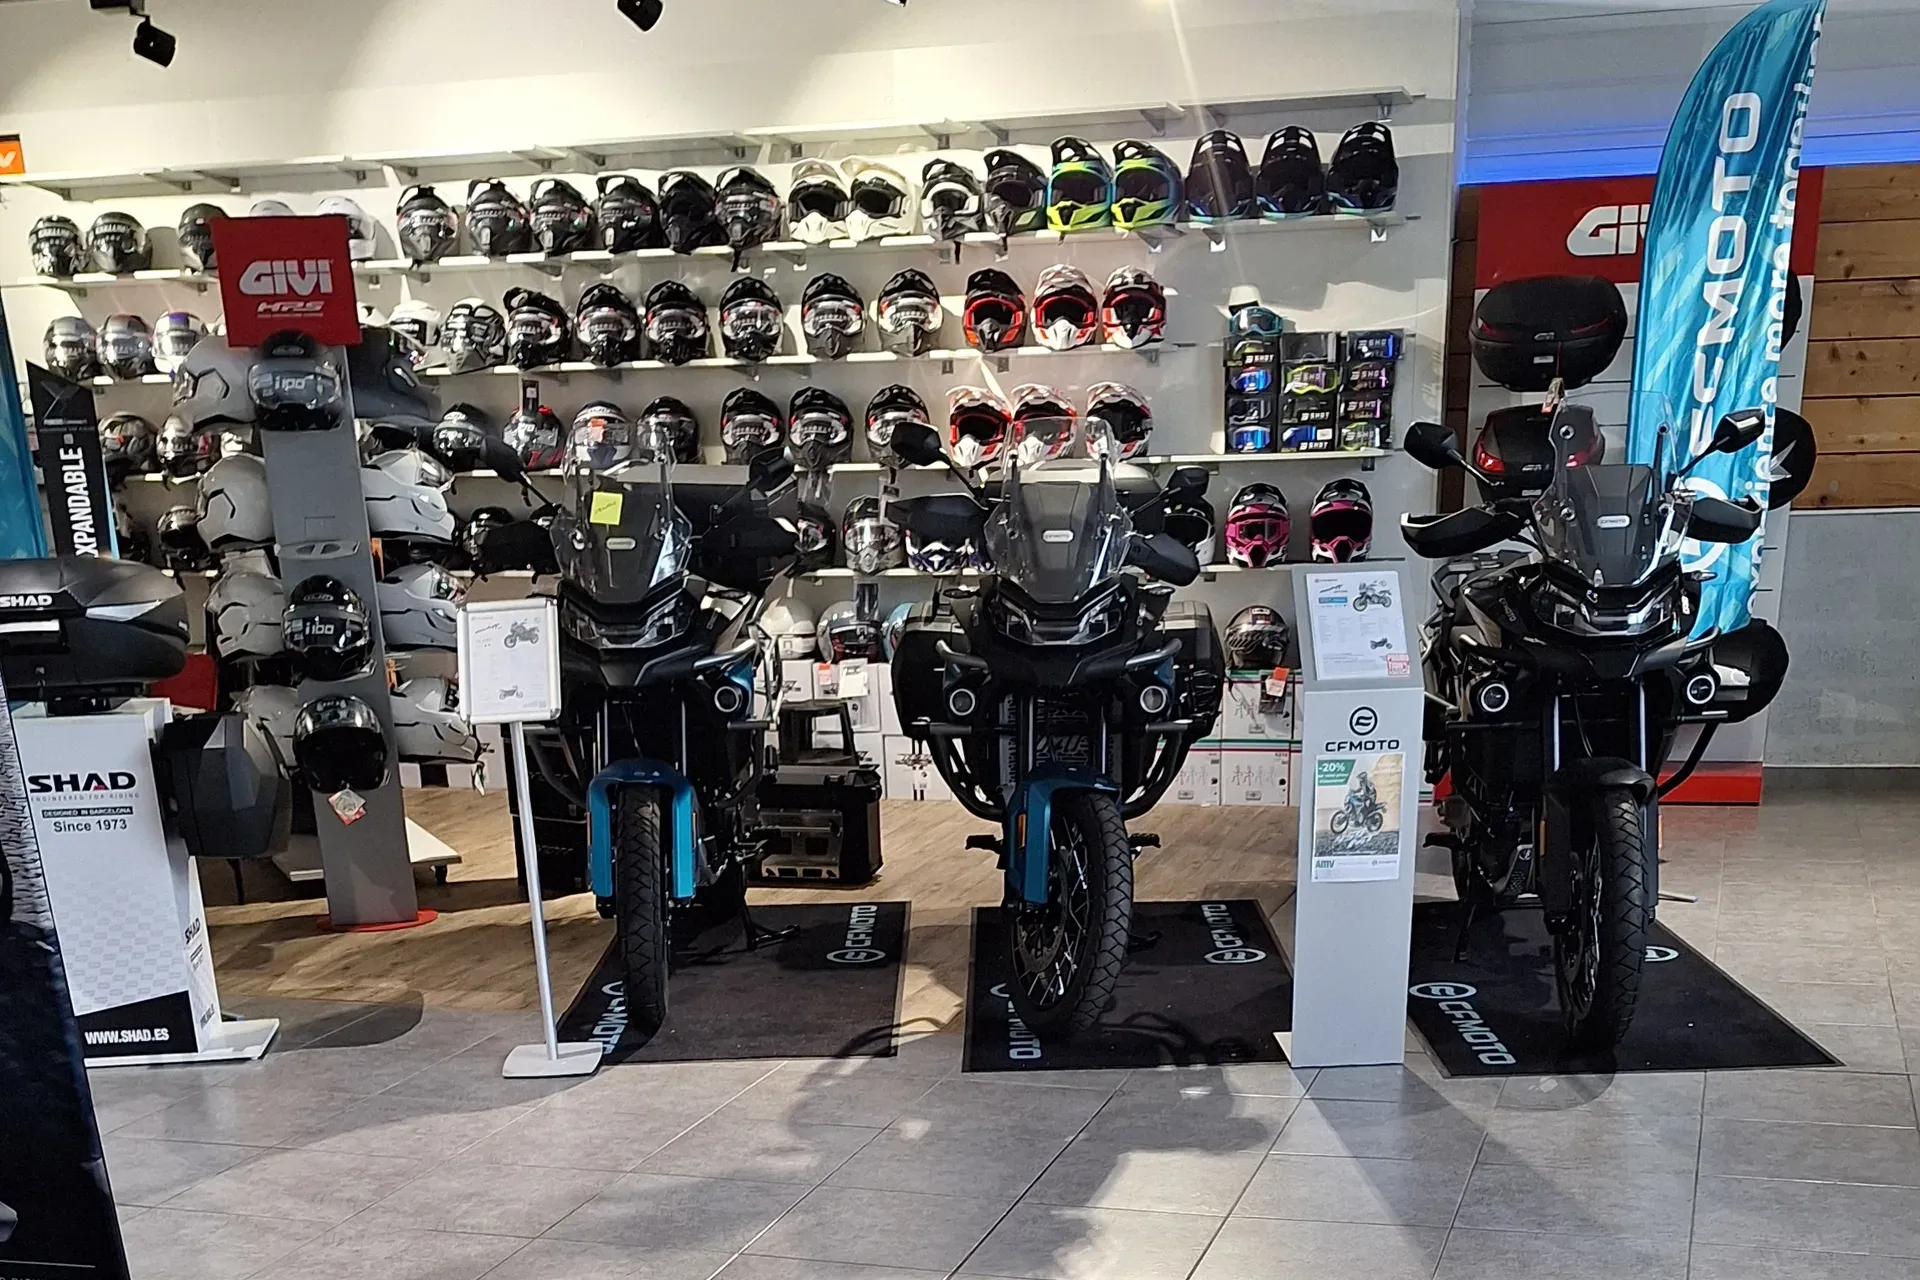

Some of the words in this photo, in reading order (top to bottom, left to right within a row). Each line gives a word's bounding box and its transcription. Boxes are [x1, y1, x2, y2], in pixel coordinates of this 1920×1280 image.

[239, 260, 333, 296] GIVI
[58, 447, 98, 558] XPANDABLE
[0, 595, 52, 607] SHAD
[1325, 739, 1400, 752] CFMOTO
[1318, 762, 1346, 773] -20%
[28, 772, 137, 794] SHAD
[90, 807, 131, 815] BARCELONA
[53, 821, 91, 832] Since
[95, 819, 127, 831] 1973
[845, 905, 878, 947] CFMOTO
[84, 1027, 170, 1045] WWW.SHAD.ES
[1438, 1001, 1516, 1065] CFMOTO
